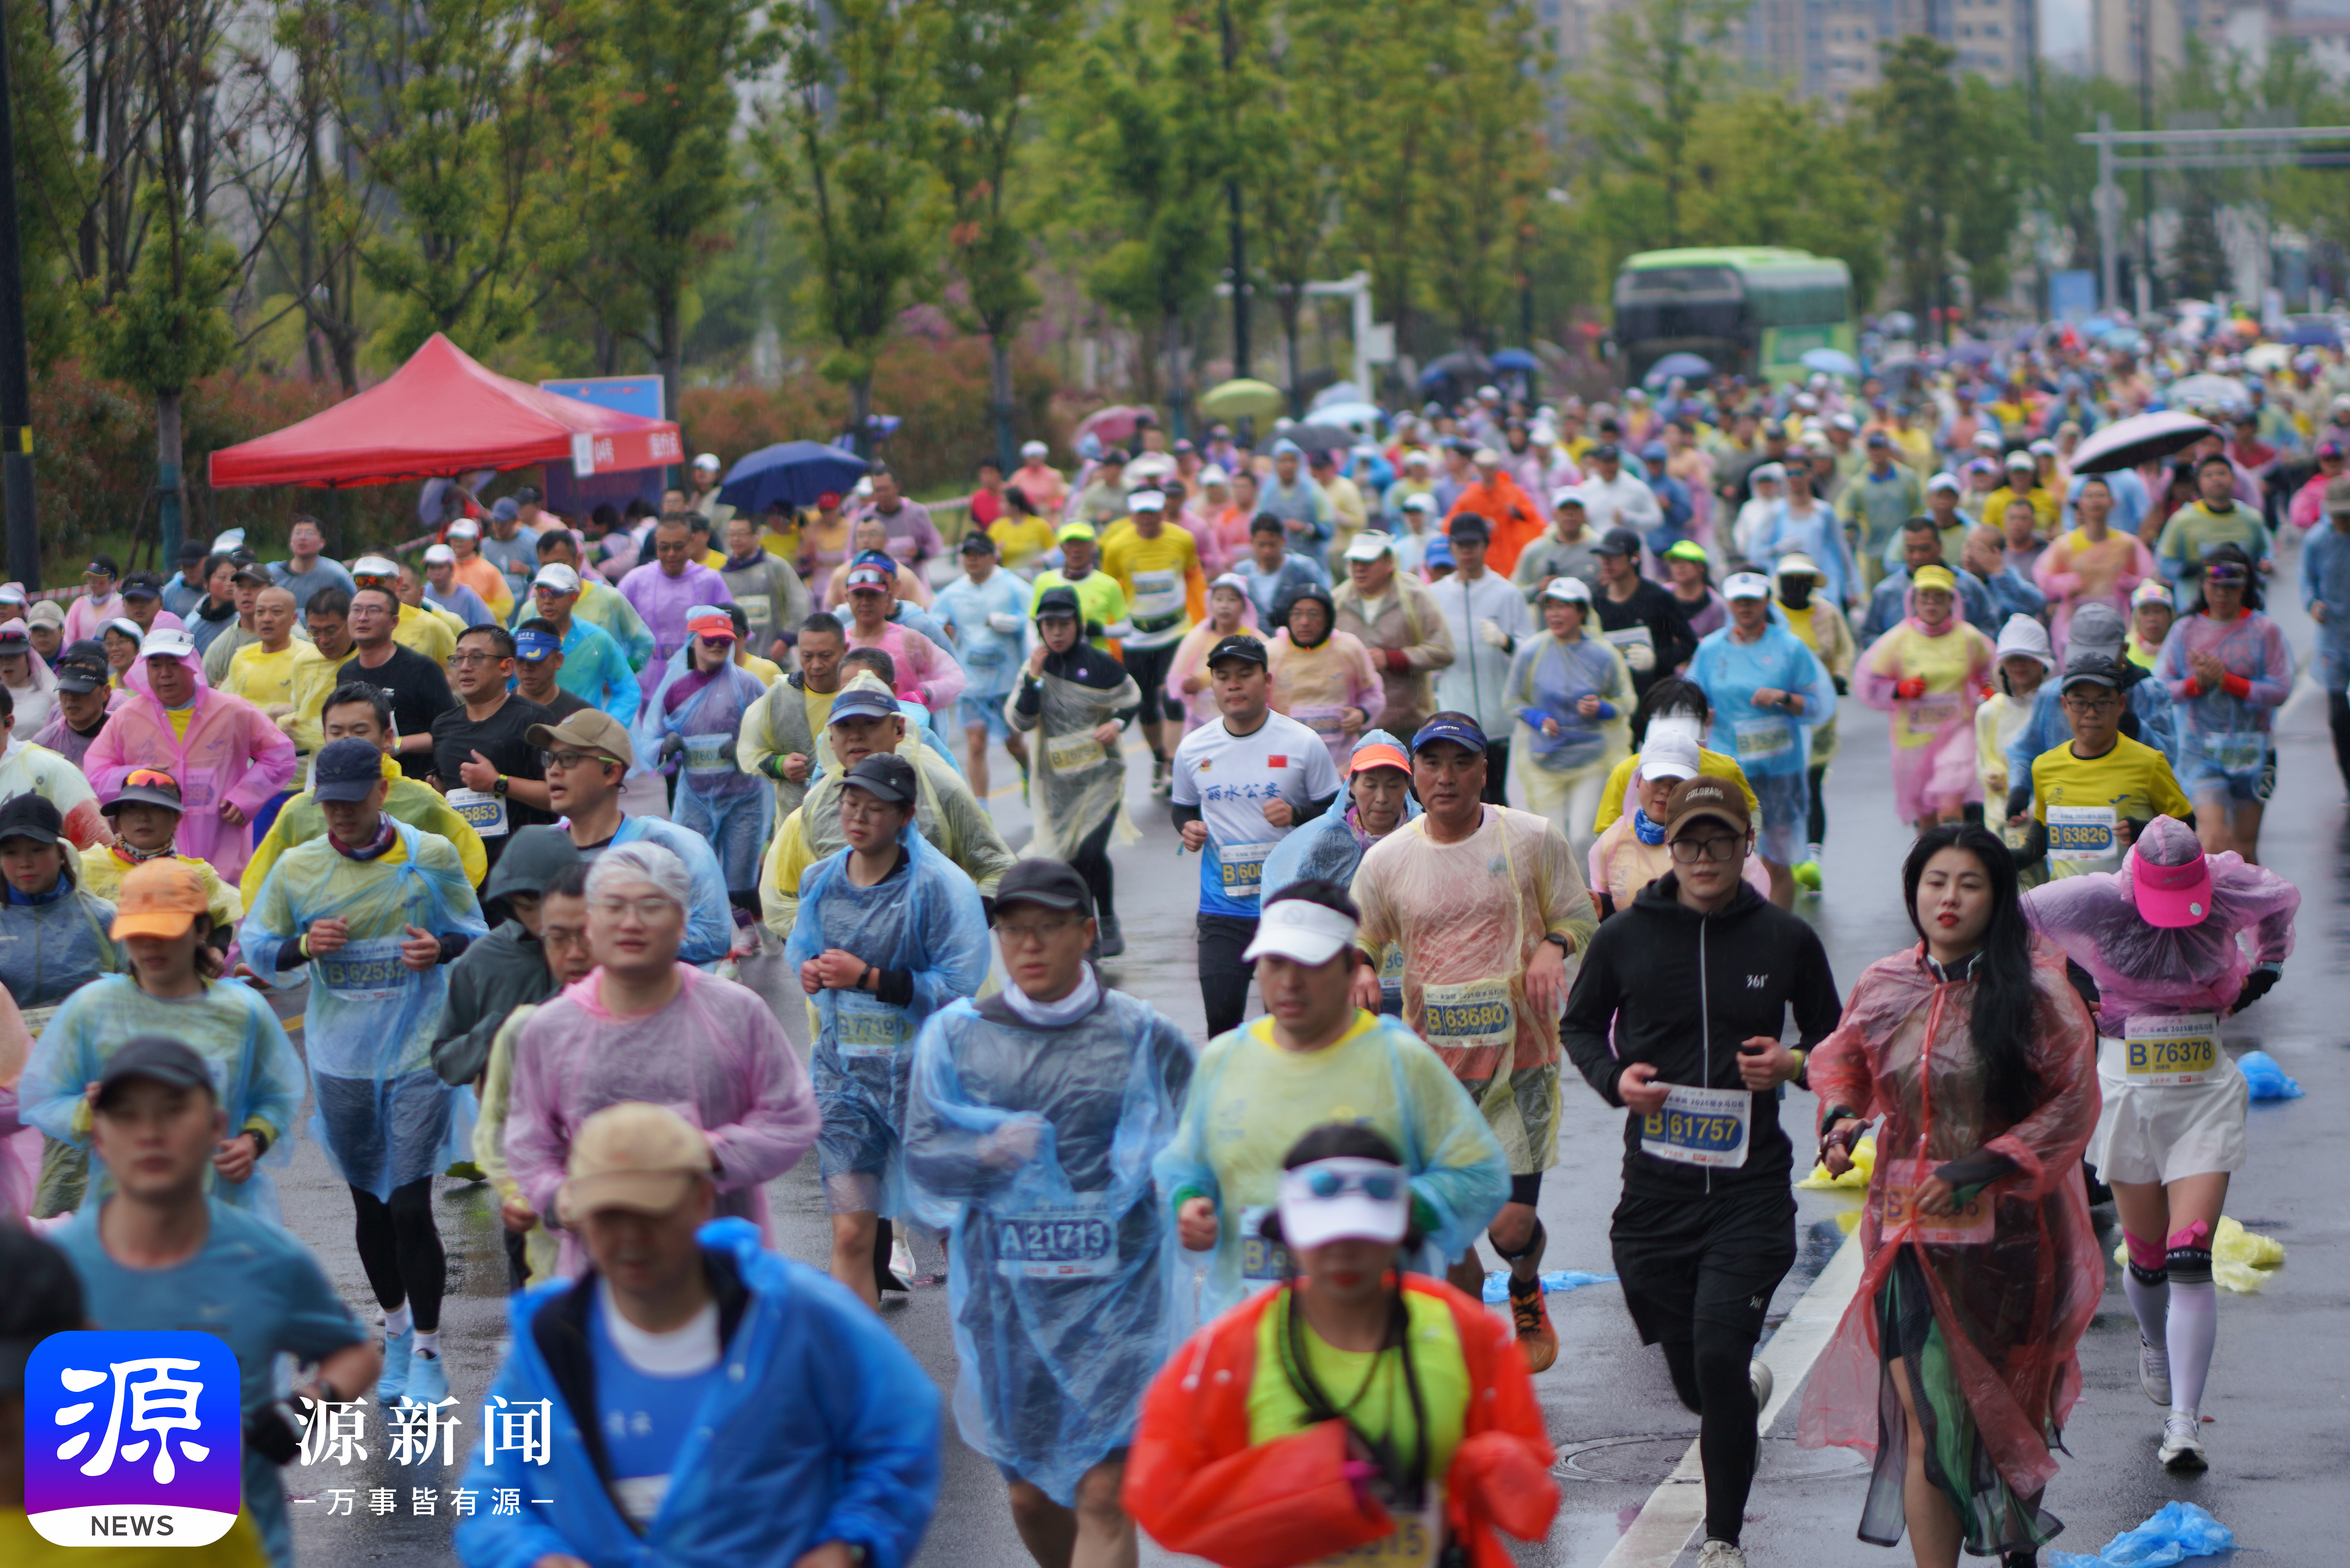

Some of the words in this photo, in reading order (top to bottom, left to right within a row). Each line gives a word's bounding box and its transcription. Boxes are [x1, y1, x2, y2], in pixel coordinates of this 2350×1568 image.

[1205, 782, 1281, 801] 丽水公安
[1685, 786, 1723, 802] COLORADO
[2049, 826, 2060, 844] B
[2063, 826, 2109, 843] 63826
[1222, 865, 1235, 882] B
[328, 964, 346, 983] B
[349, 959, 407, 982] 62532
[1427, 1008, 1442, 1029] B
[1445, 1004, 1505, 1027] 63680
[2129, 1043, 2147, 1066] B
[2153, 1040, 2211, 1062] 76378
[1645, 1112, 1663, 1135] B
[1670, 1113, 1738, 1141] 61757
[1001, 1224, 1022, 1251] A
[1028, 1223, 1104, 1249] 21713
[1245, 1240, 1264, 1270] B
